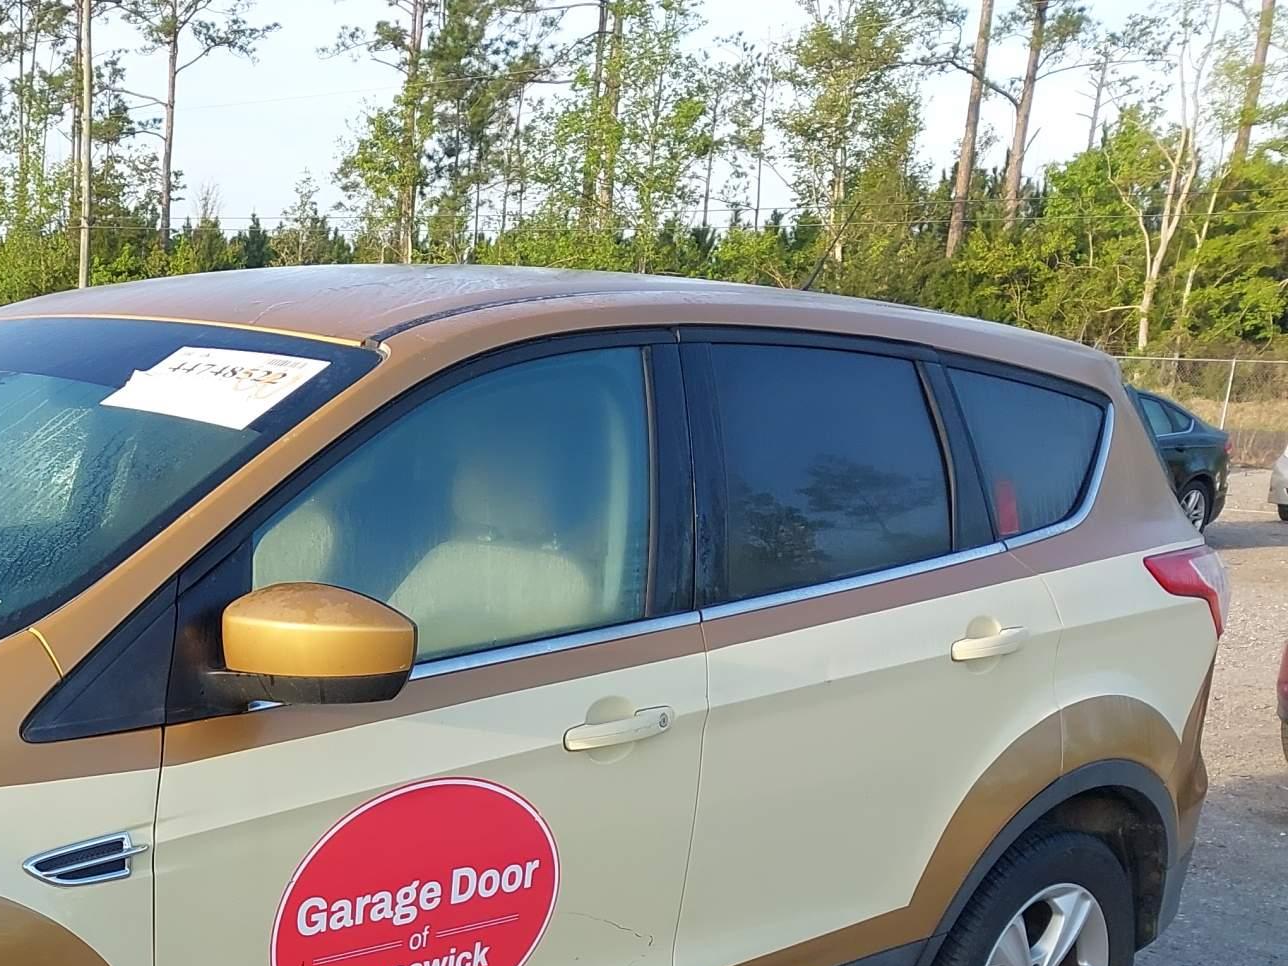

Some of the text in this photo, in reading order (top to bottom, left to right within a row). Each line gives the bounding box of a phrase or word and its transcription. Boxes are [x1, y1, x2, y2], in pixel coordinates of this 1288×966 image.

[169, 362, 287, 385] 44748522
[296, 859, 540, 937] Garage Door
[409, 925, 431, 951] of
